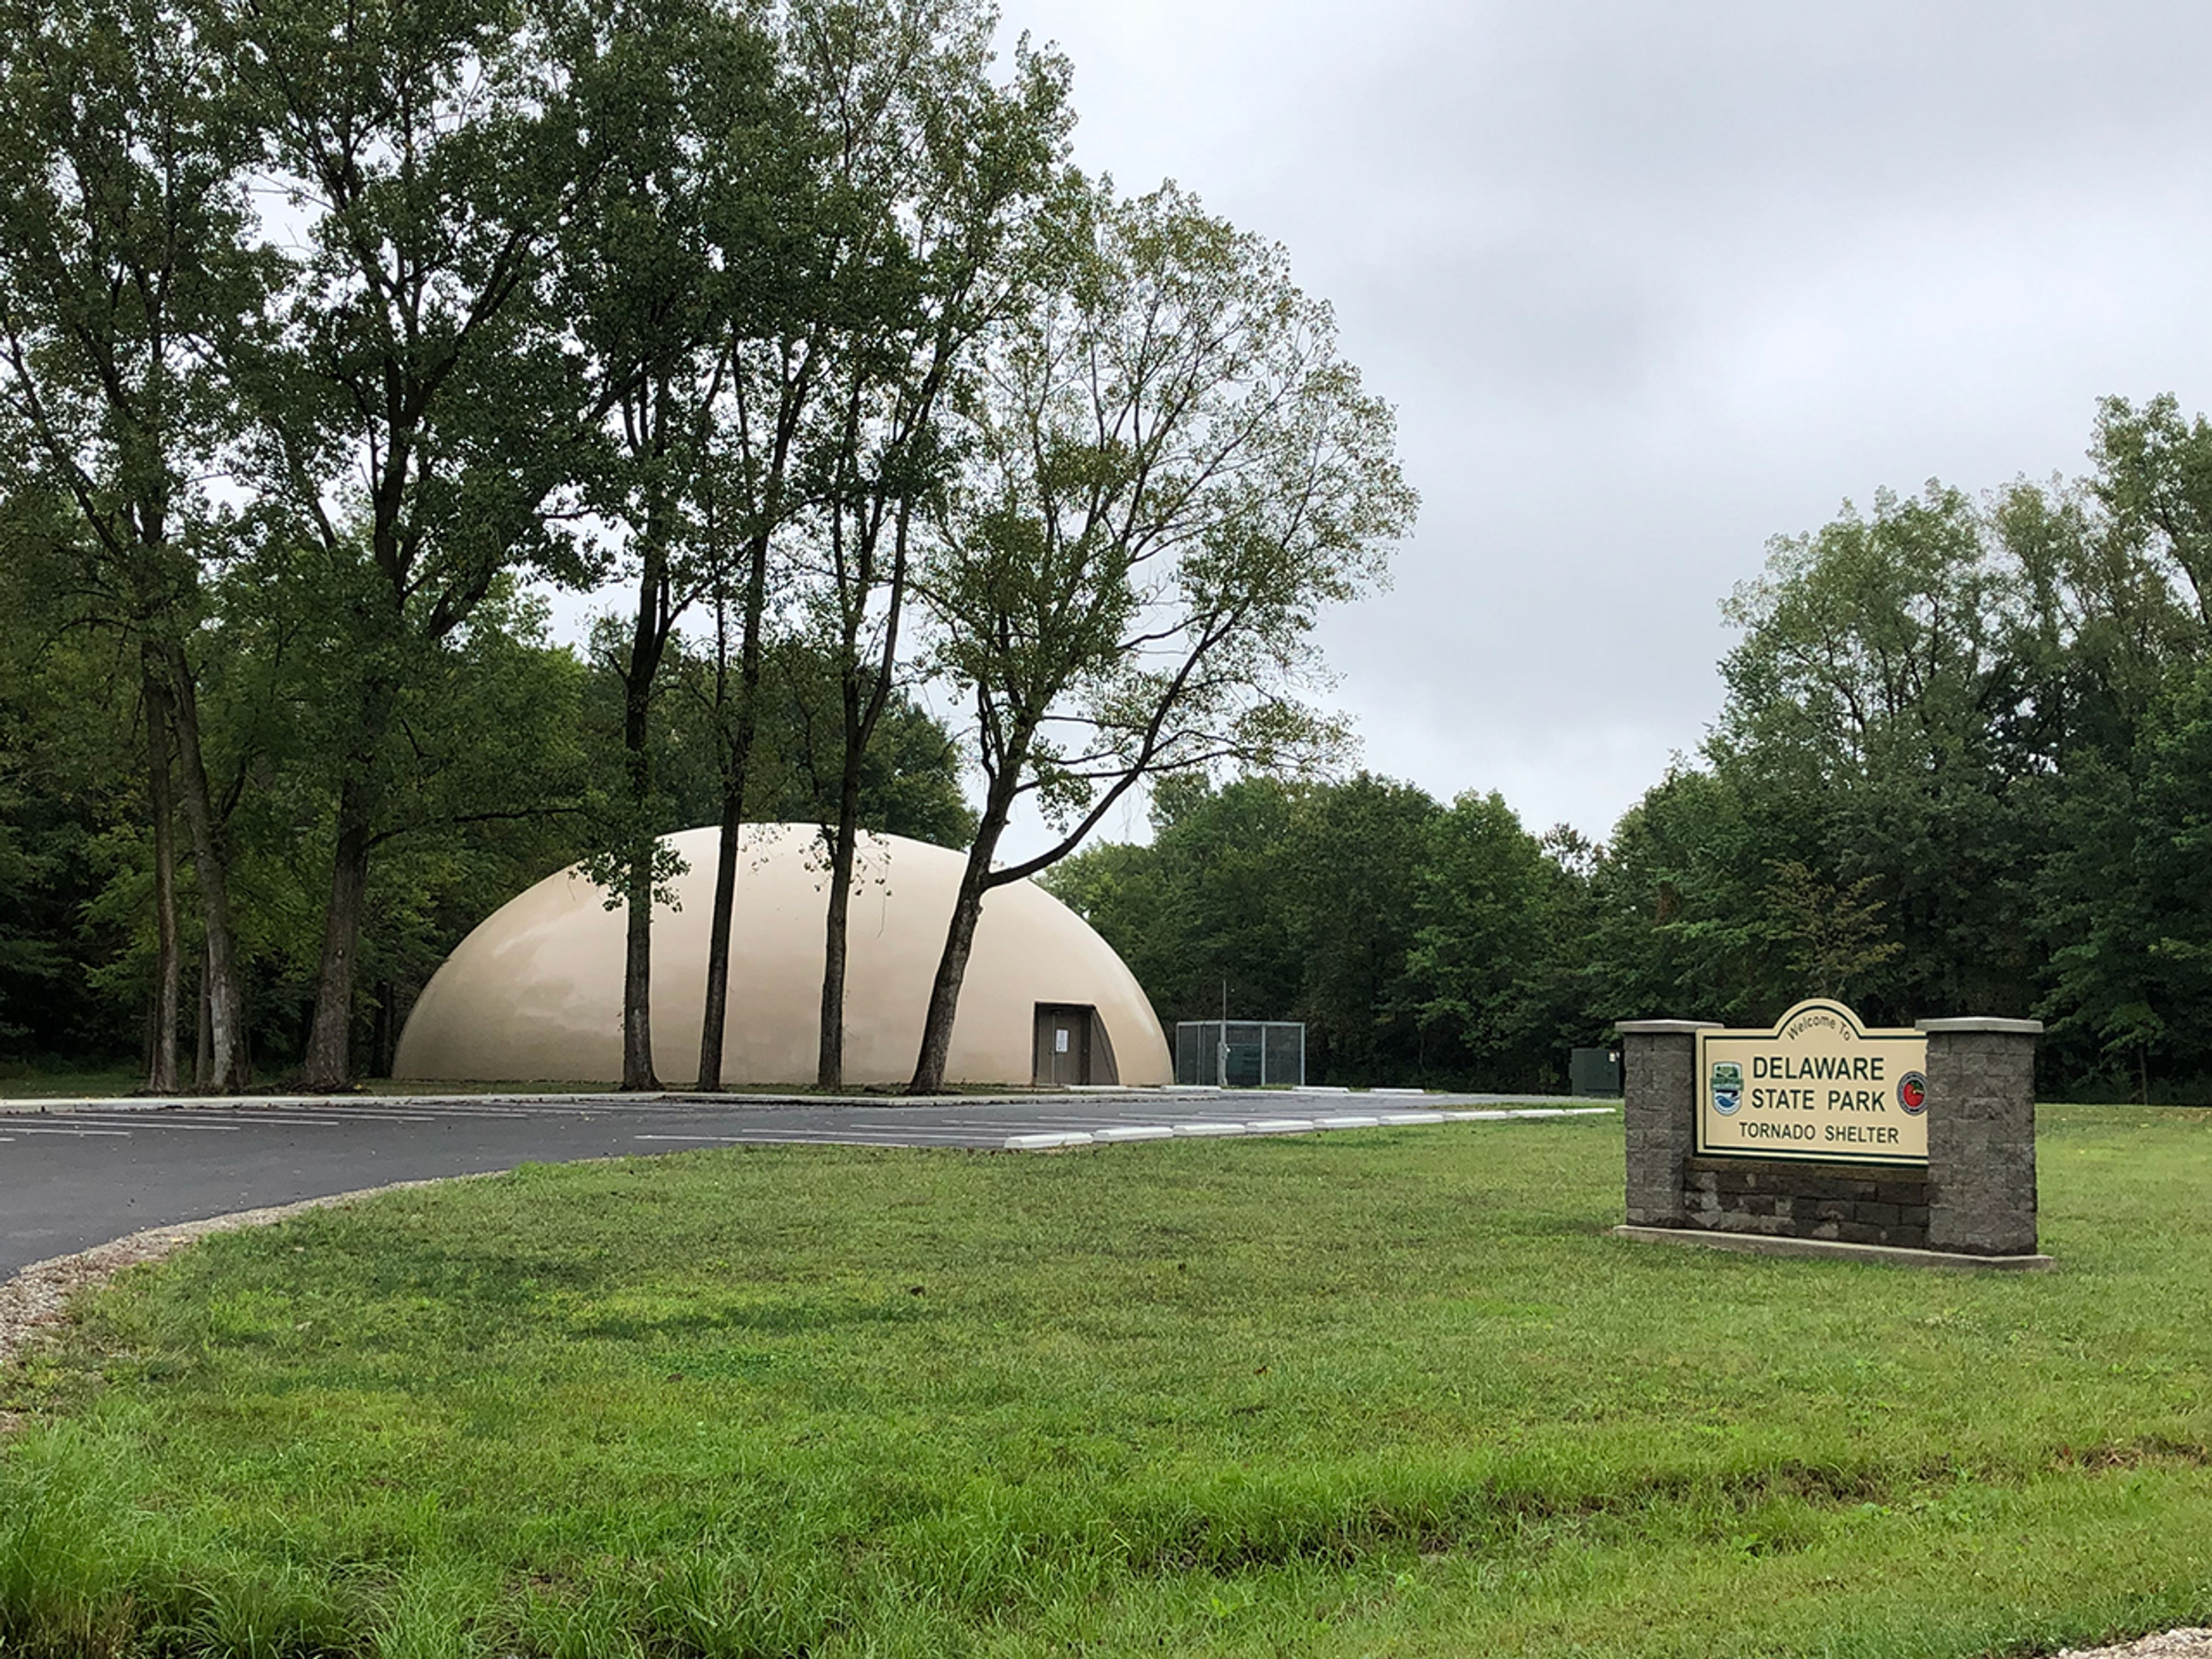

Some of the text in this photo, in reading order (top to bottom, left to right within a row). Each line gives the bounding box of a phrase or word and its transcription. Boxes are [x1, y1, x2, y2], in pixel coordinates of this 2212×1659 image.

[1787, 1016, 1851, 1041] Welcome To
[1753, 1057, 1884, 1080] DELAWARE
[1752, 1089, 1815, 1110] STATE
[1828, 1091, 1886, 1112] PARK
[1739, 1122, 1899, 1143] TORNADO SHELTER
